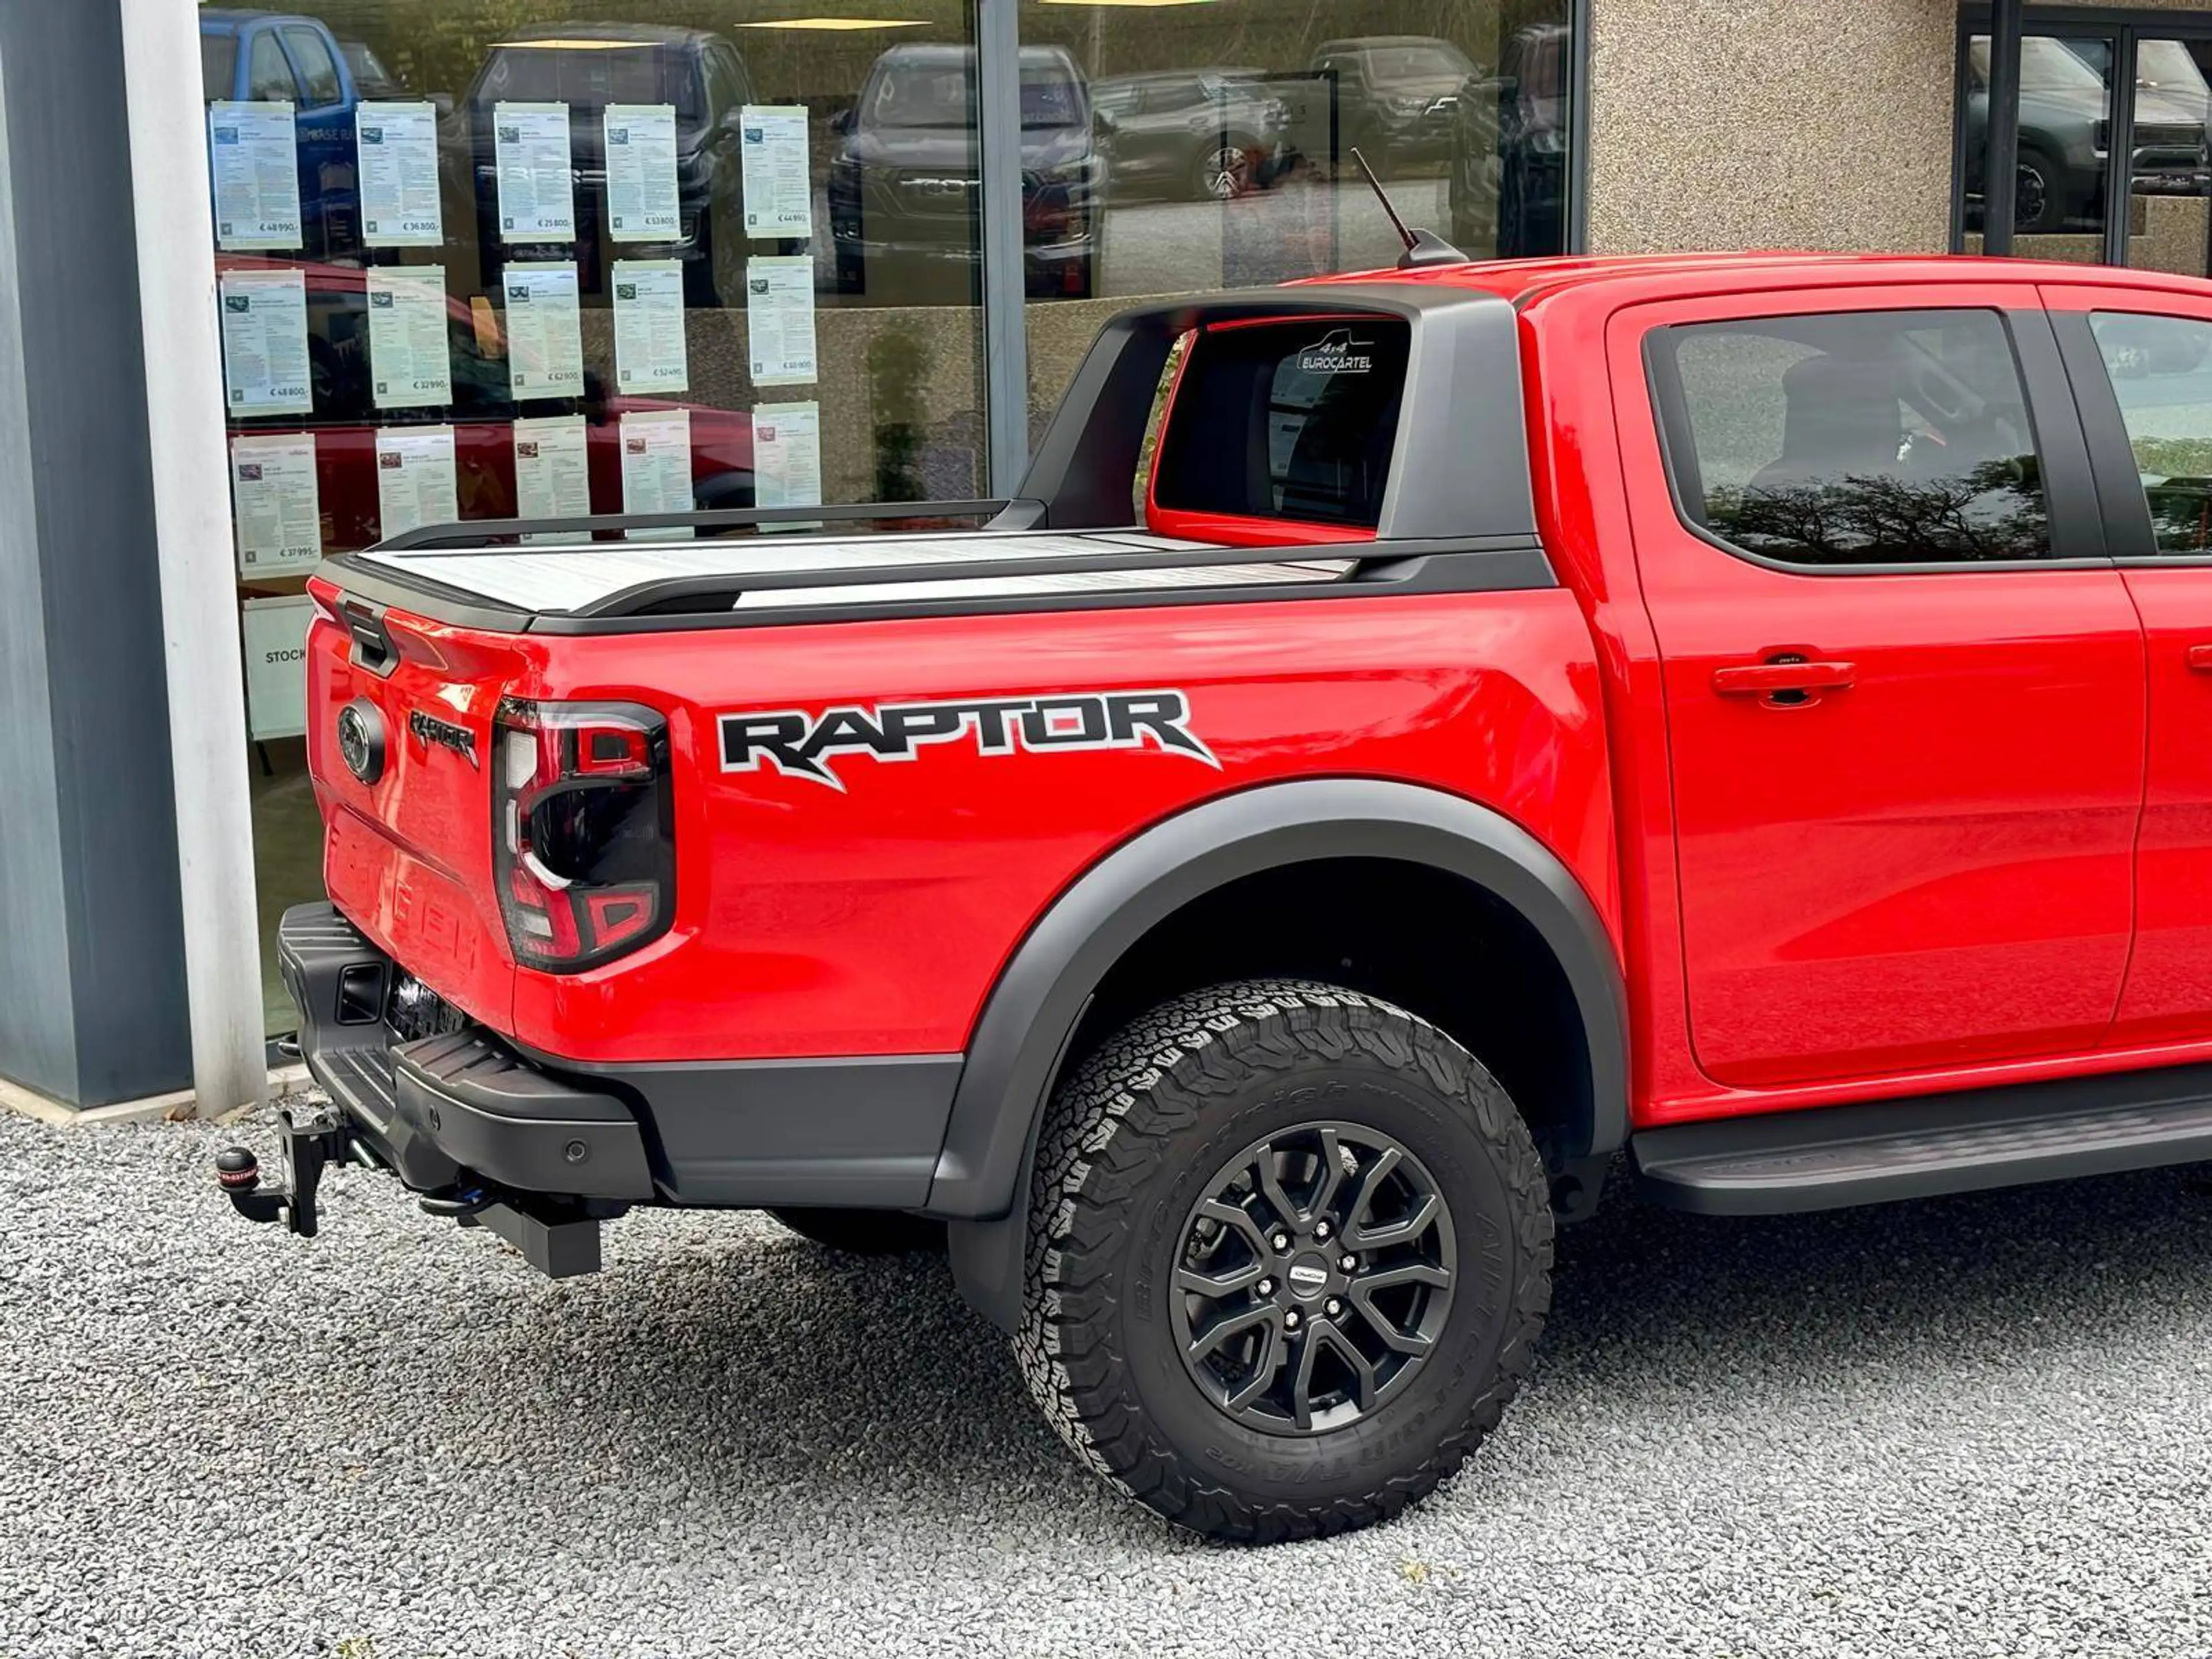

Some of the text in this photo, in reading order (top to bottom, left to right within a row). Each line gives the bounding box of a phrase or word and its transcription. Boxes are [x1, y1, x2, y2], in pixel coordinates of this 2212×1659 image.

[1302, 356, 1373, 372] EUROCARTEL
[410, 709, 480, 772] RAPTOR
[716, 688, 1222, 794] RAPTOR
